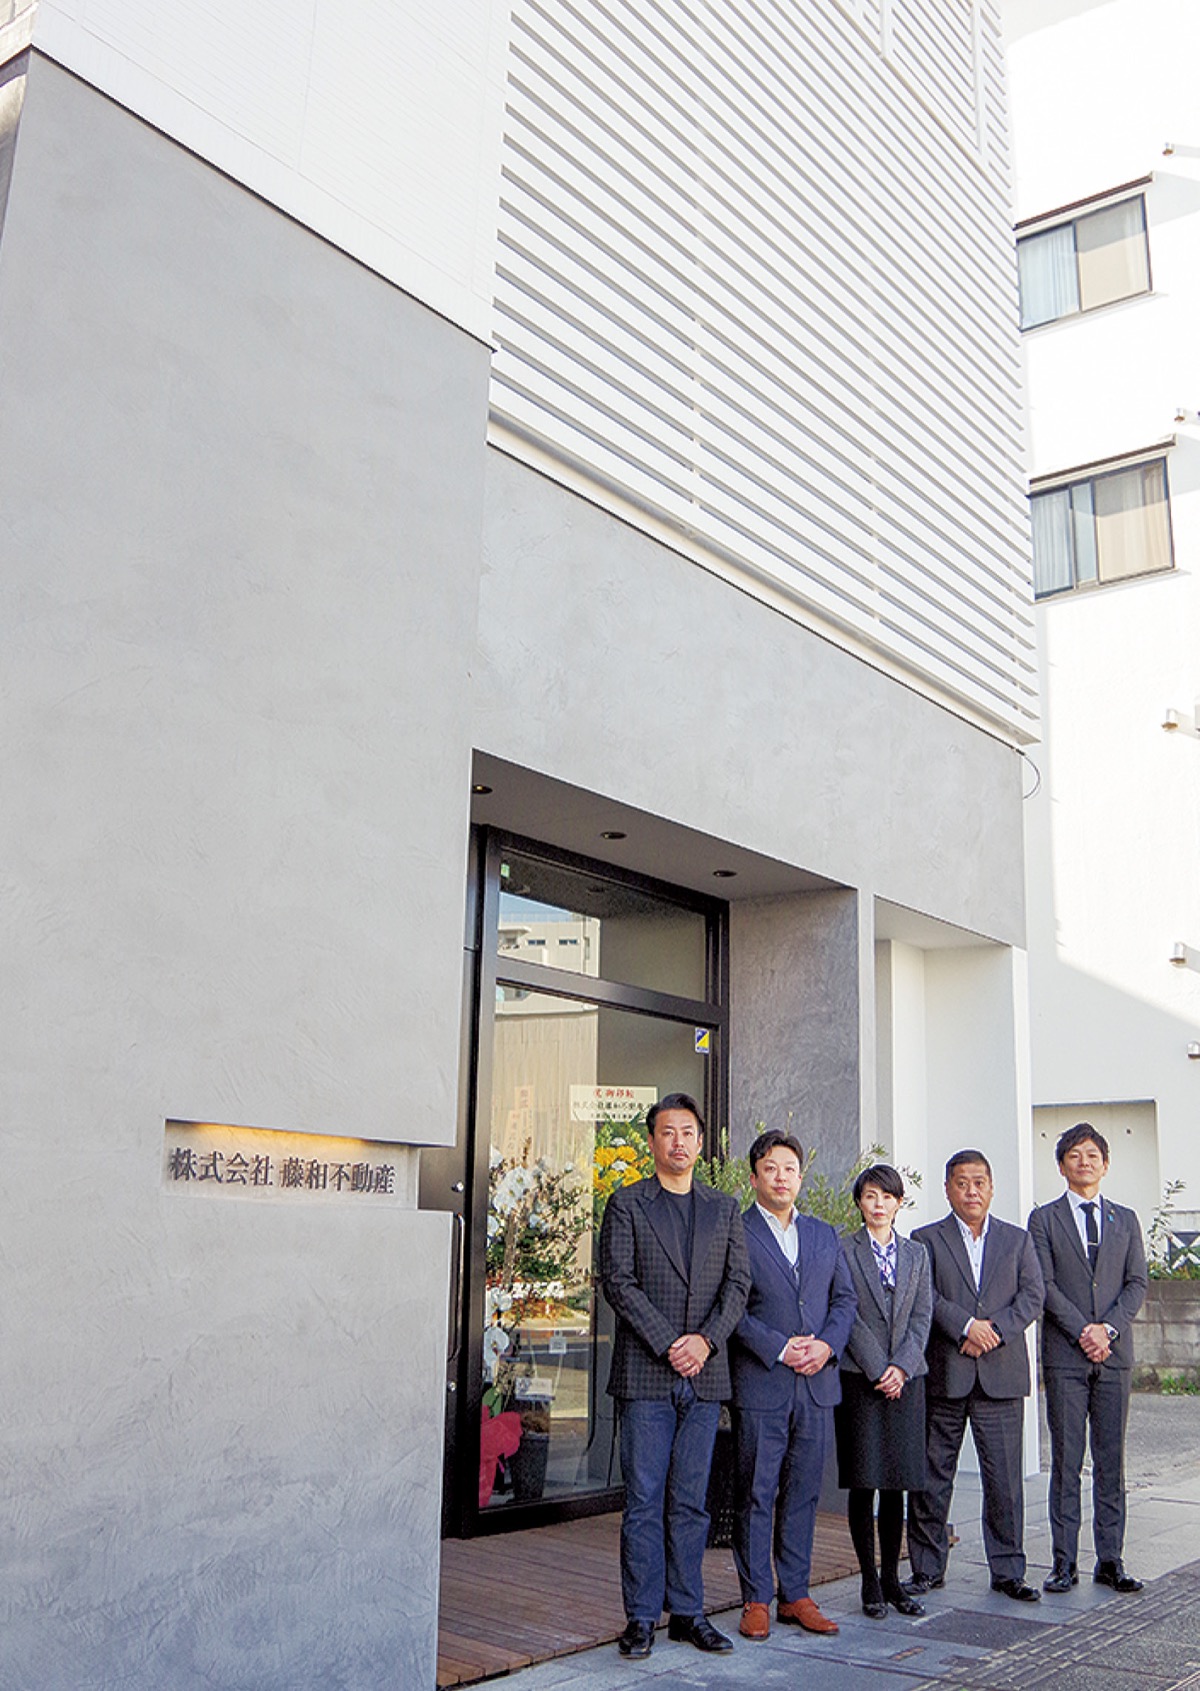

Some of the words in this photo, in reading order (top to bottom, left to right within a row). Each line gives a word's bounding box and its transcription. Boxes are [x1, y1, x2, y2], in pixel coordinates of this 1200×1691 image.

[169, 1147, 274, 1186] 株式会社
[279, 1156, 396, 1194] 藤和不動産
